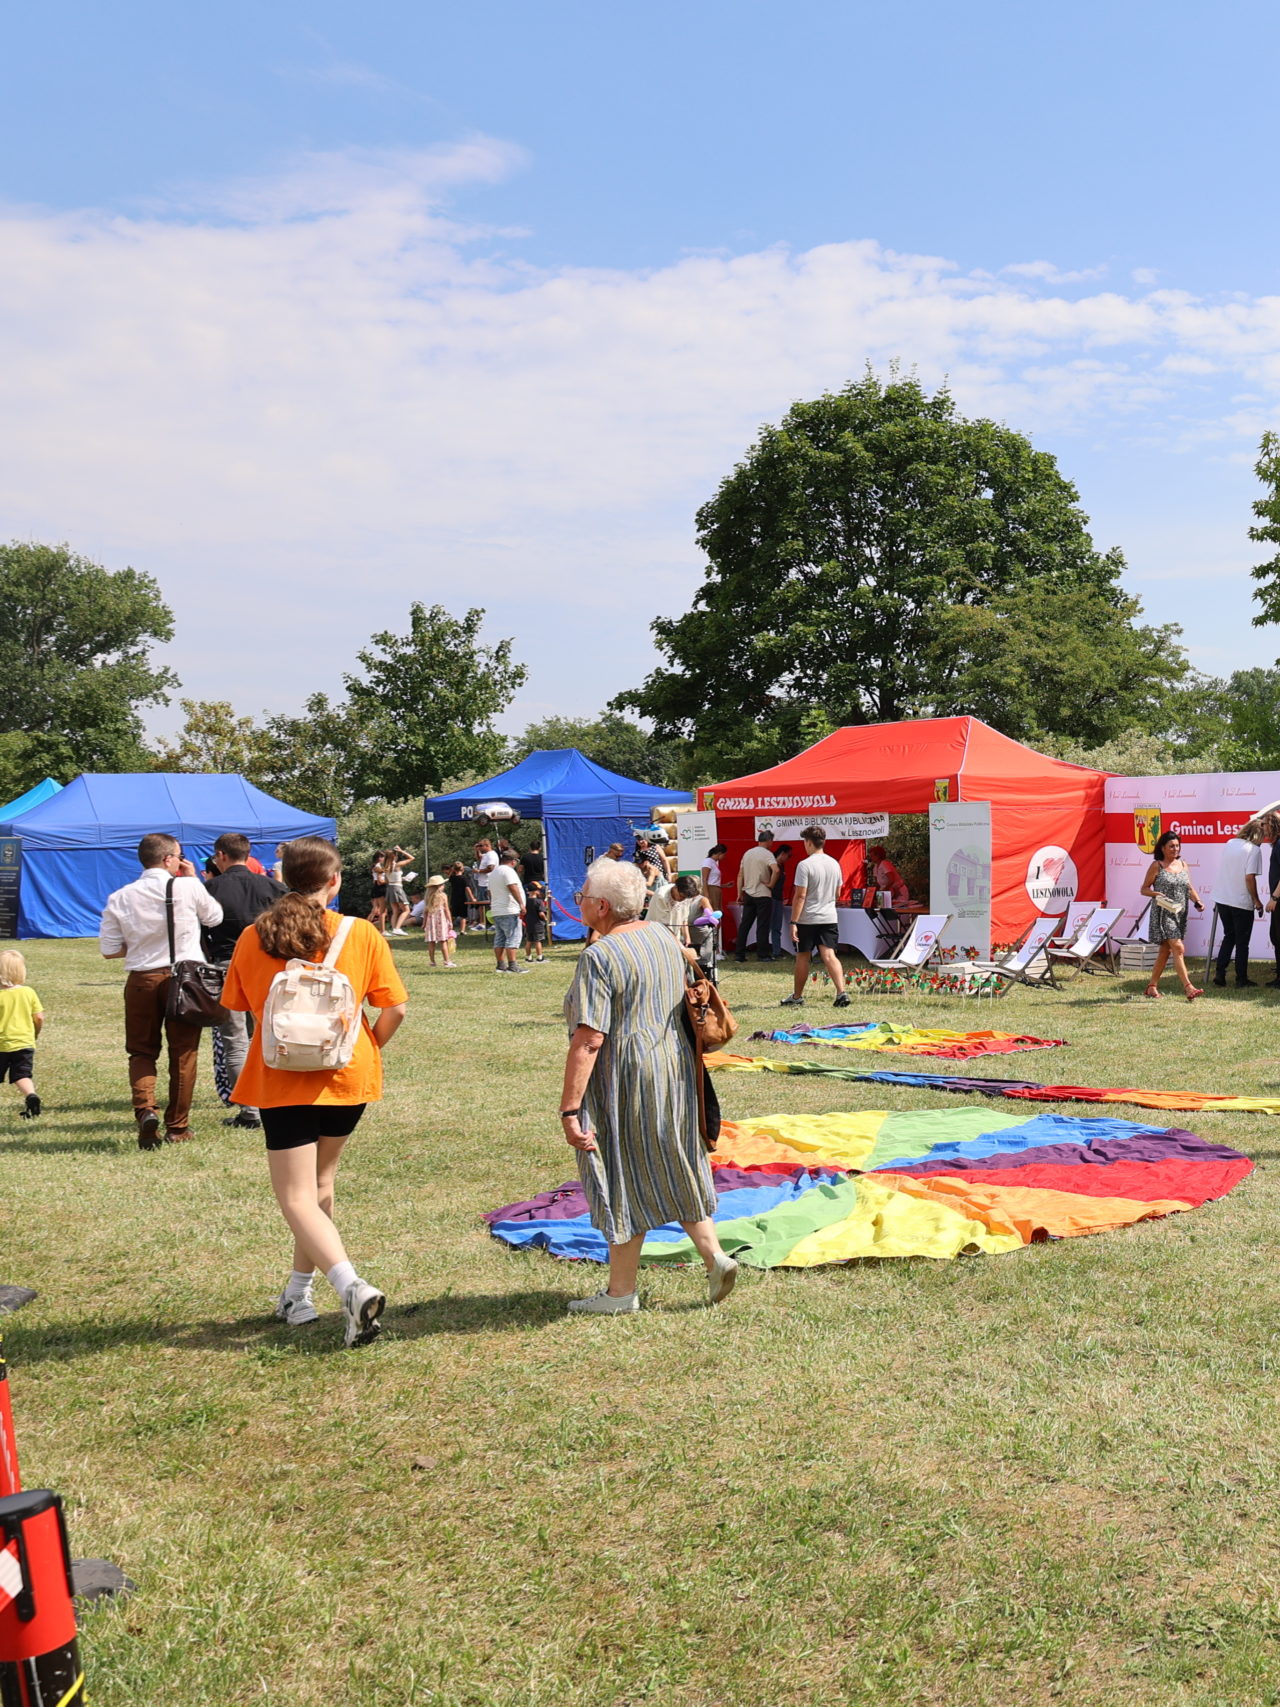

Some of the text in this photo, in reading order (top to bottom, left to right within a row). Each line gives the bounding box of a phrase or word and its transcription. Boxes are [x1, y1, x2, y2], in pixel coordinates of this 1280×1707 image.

[717, 794, 837, 810] GMINA LESZNOWOLA
[776, 814, 885, 828] GMINNA BIBLIOTEKA PUBLICZNA
[1170, 821, 1214, 835] Gmina
[1035, 866, 1040, 879] I
[1032, 887, 1074, 898] LESZNOWOLA
